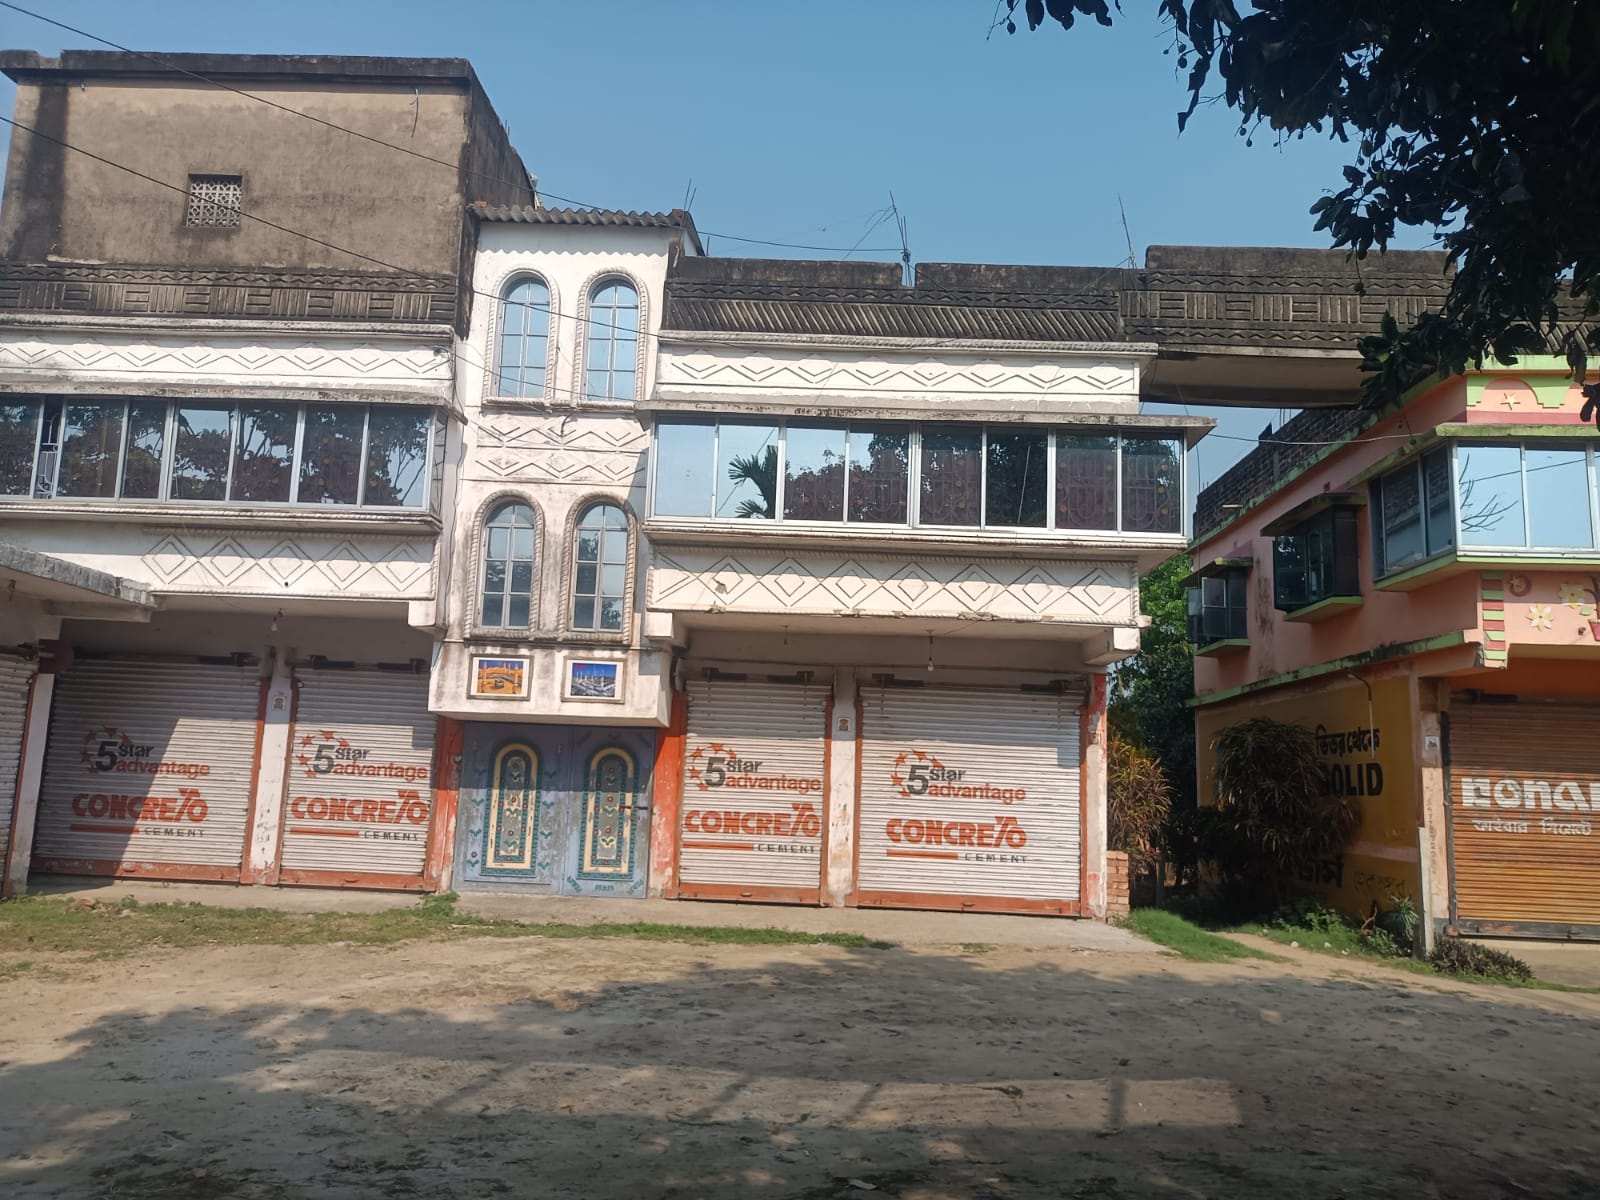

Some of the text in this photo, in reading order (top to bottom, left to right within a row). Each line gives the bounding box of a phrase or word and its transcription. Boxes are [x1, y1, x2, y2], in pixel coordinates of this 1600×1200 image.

[95, 740, 118, 772] 5
[116, 757, 210, 780] advantage
[313, 744, 335, 775] 5
[333, 760, 429, 782] advantage
[704, 757, 726, 787] 5
[725, 773, 822, 795] advantage
[906, 764, 930, 795] 5
[71, 787, 208, 823] CONCRETO
[928, 781, 1027, 805] advantage
[290, 789, 430, 825] CONCRETO
[685, 803, 821, 837] CONCRETO
[144, 827, 204, 838] CEMENT
[364, 831, 419, 841] CEMENT
[886, 816, 1028, 849] CONCRETO
[757, 843, 816, 853] CEMENT
[964, 853, 1027, 863] CEMENT
